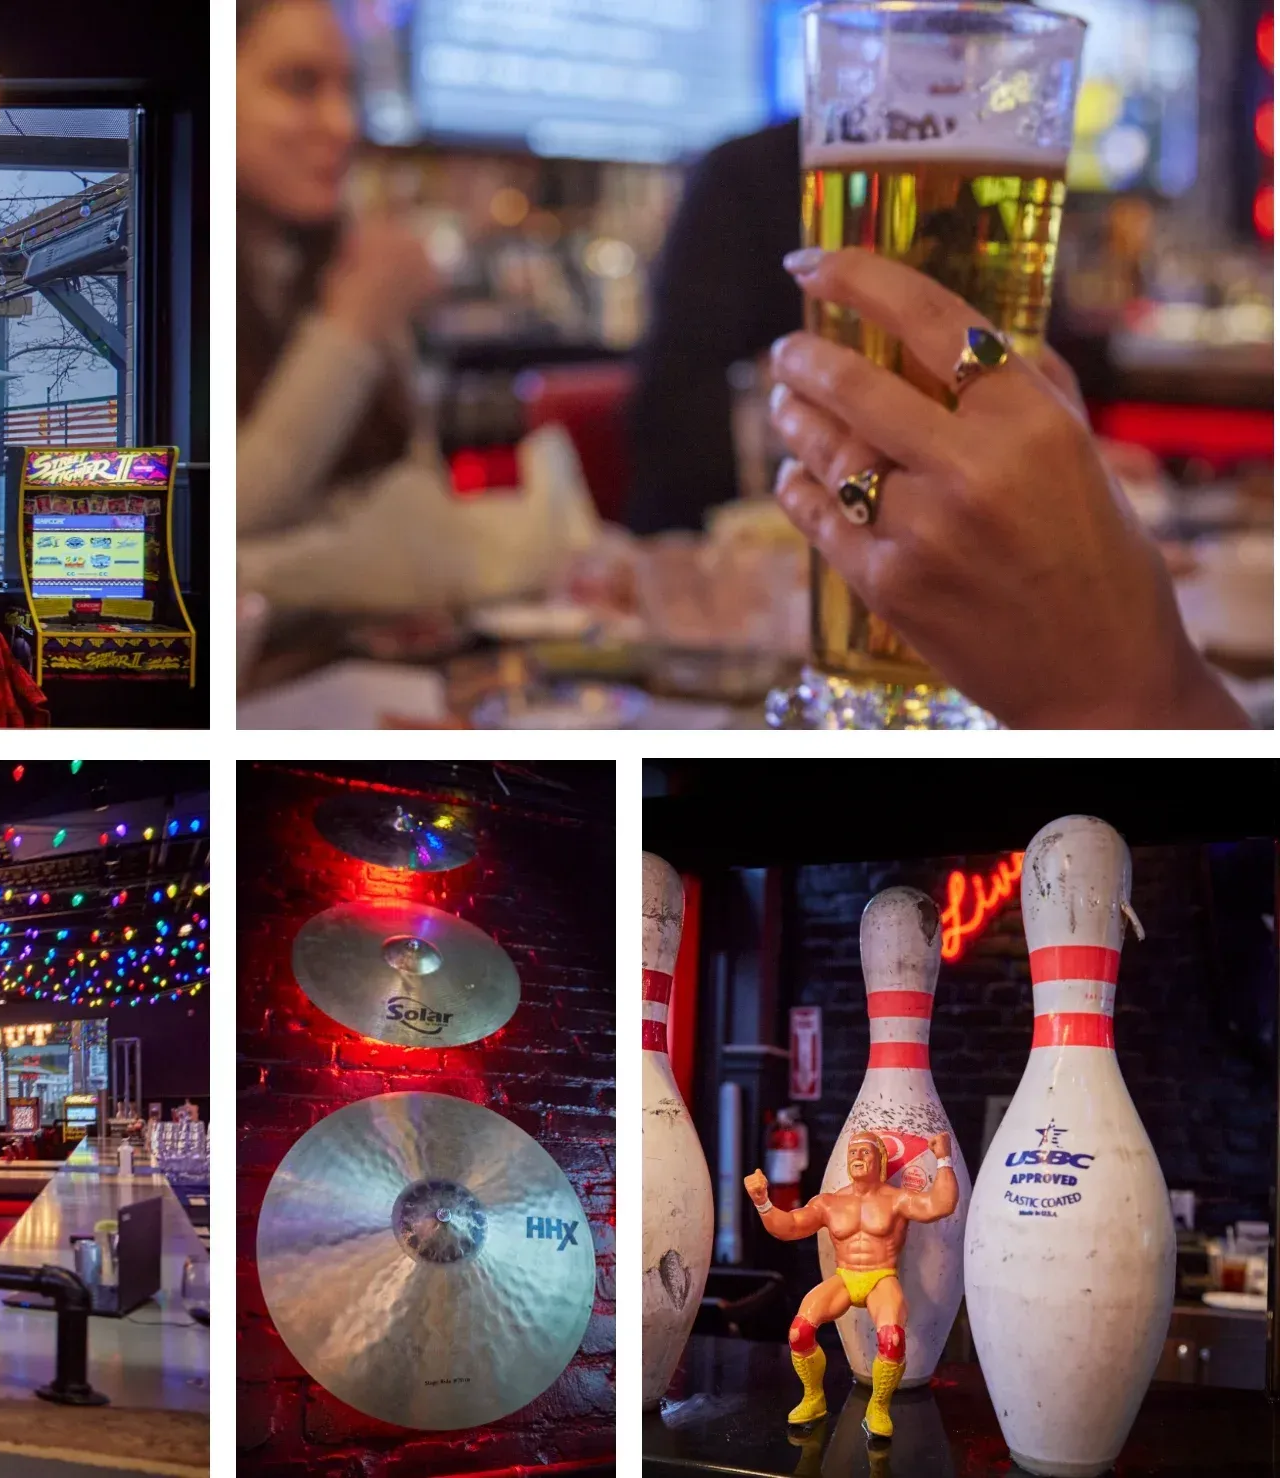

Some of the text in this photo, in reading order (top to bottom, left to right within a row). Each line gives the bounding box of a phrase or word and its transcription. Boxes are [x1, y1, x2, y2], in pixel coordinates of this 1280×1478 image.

[28, 452, 89, 481] STREET
[42, 459, 117, 484] FIGHTER
[386, 1004, 454, 1024] Solar
[1005, 1149, 1095, 1170] USBC
[1010, 1172, 1078, 1187] APPROVED
[1004, 1190, 1082, 1209] PLASTIC COATED
[526, 1216, 579, 1252] HHX
